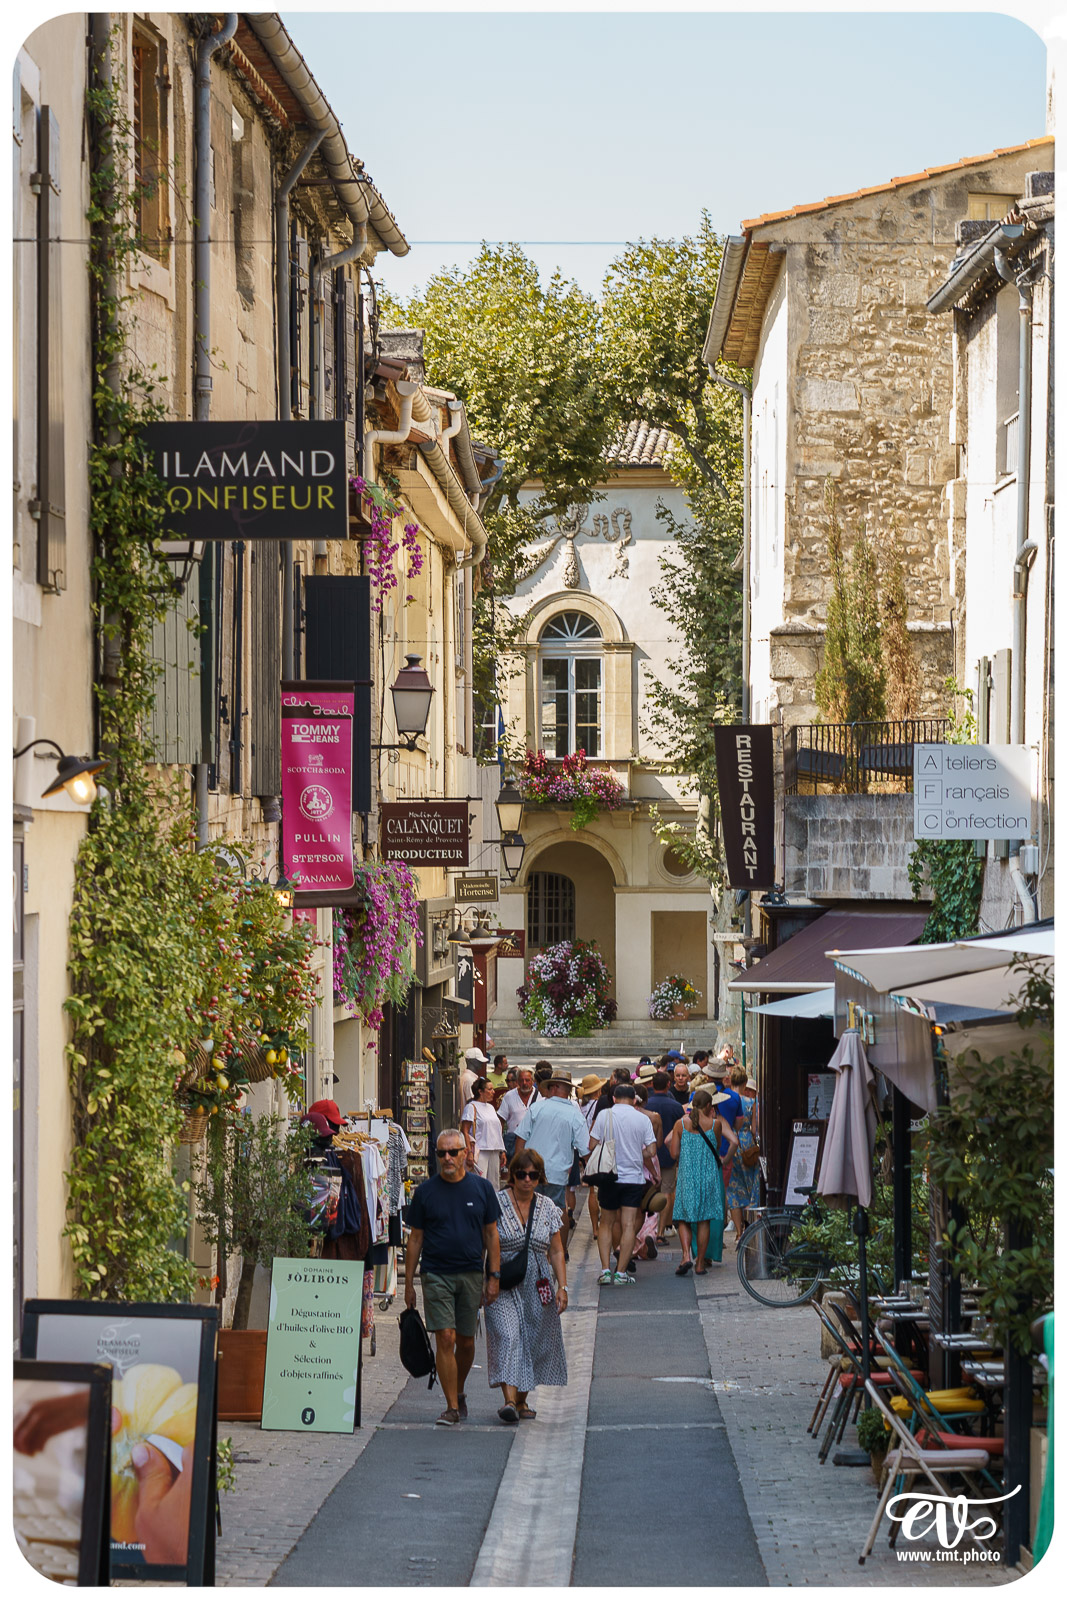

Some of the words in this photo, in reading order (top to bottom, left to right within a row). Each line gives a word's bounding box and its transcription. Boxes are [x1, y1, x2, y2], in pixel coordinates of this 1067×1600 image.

[292, 725, 340, 735] TOMMY
[311, 735, 340, 743] JEANS
[735, 734, 758, 880] RESTAURANT
[386, 819, 464, 835] CALANQUET
[295, 833, 341, 843] PULLIN
[292, 854, 345, 863] STETSON
[387, 849, 463, 859] PRODUCTEUR
[299, 874, 342, 883] PANAMA
[459, 888, 494, 897] Hortense
[291, 1308, 341, 1319] Dégustation
[336, 1326, 354, 1335] BIO
[309, 1340, 316, 1348] &
[293, 1354, 332, 1364] Sélection
[313, 1371, 343, 1380] raffinés
